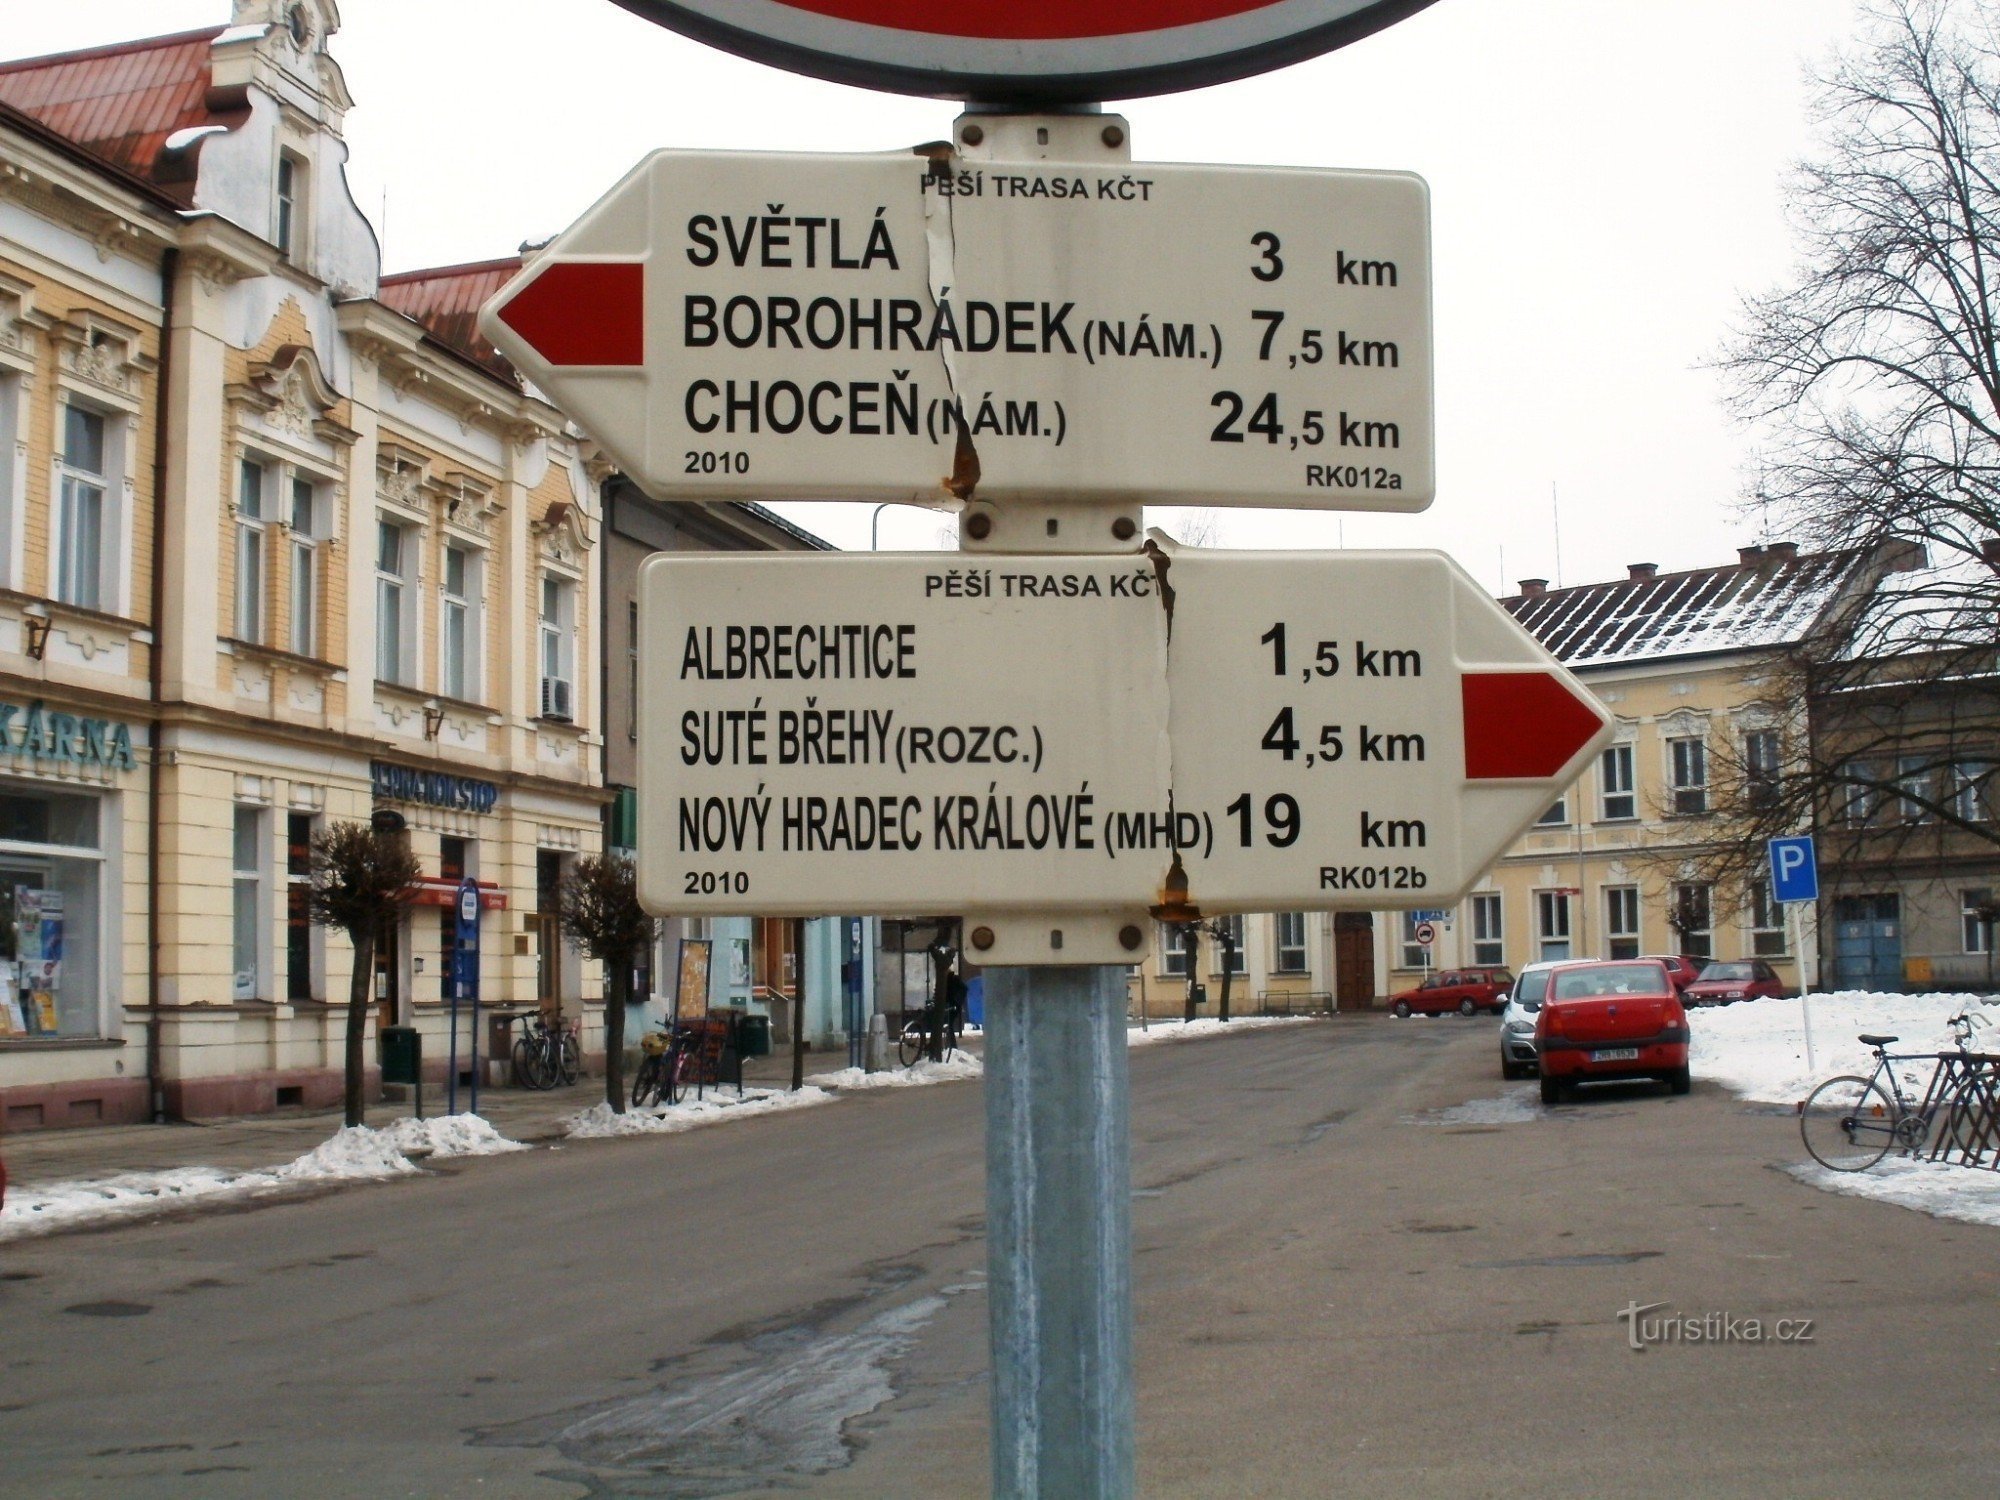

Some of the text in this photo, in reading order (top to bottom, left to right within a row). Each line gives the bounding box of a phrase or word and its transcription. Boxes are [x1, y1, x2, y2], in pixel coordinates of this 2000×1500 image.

[992, 176, 1090, 199] TRASA
[1098, 175, 1154, 201] KČT
[686, 203, 1397, 287] SVĚTLÁ 3 km
[1251, 309, 1323, 369] 7,5
[1338, 330, 1399, 368] km
[1210, 390, 1324, 451] 24,5
[1340, 411, 1400, 449] km
[685, 451, 750, 474] 2010
[1306, 464, 1402, 490] RK012a
[925, 569, 991, 598] PĚŠÍ
[1000, 575, 1102, 598] TRASA
[680, 622, 1422, 684] ALBRECHTICE 1,5 km
[680, 696, 768, 765] SUTÉ
[1261, 706, 1344, 768] 4,5
[1360, 725, 1425, 762] km
[679, 780, 1427, 860] NOVÝ HRADEC KRÁLOVÉ (MHD) 19 km
[1320, 866, 1427, 890] RK012b
[1778, 845, 1805, 882] P
[684, 871, 750, 894] 2010
